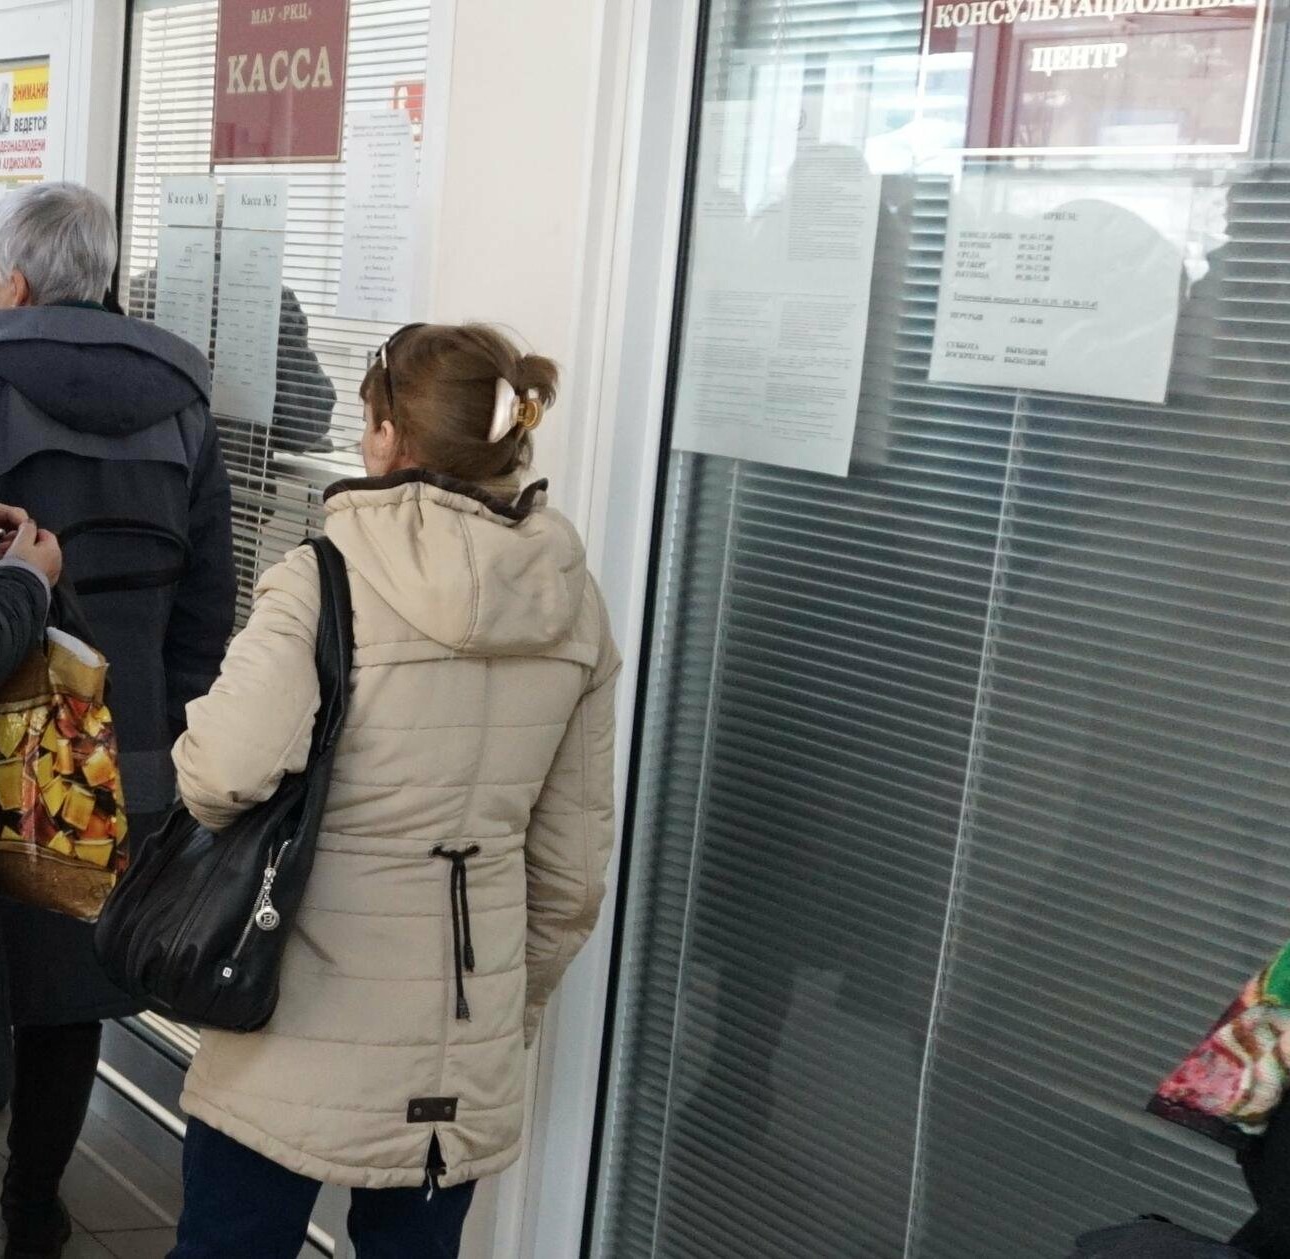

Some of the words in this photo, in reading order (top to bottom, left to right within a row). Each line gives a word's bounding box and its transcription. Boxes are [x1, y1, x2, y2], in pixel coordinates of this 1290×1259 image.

[251, 8, 276, 24] МАУ
[934, 0, 1256, 28] КОНСУЛЬТАЦИО
[226, 46, 333, 94] КАССА
[1030, 43, 1128, 76] ЦЕНТР
[14, 116, 47, 134] ВЕДЕТСЯ
